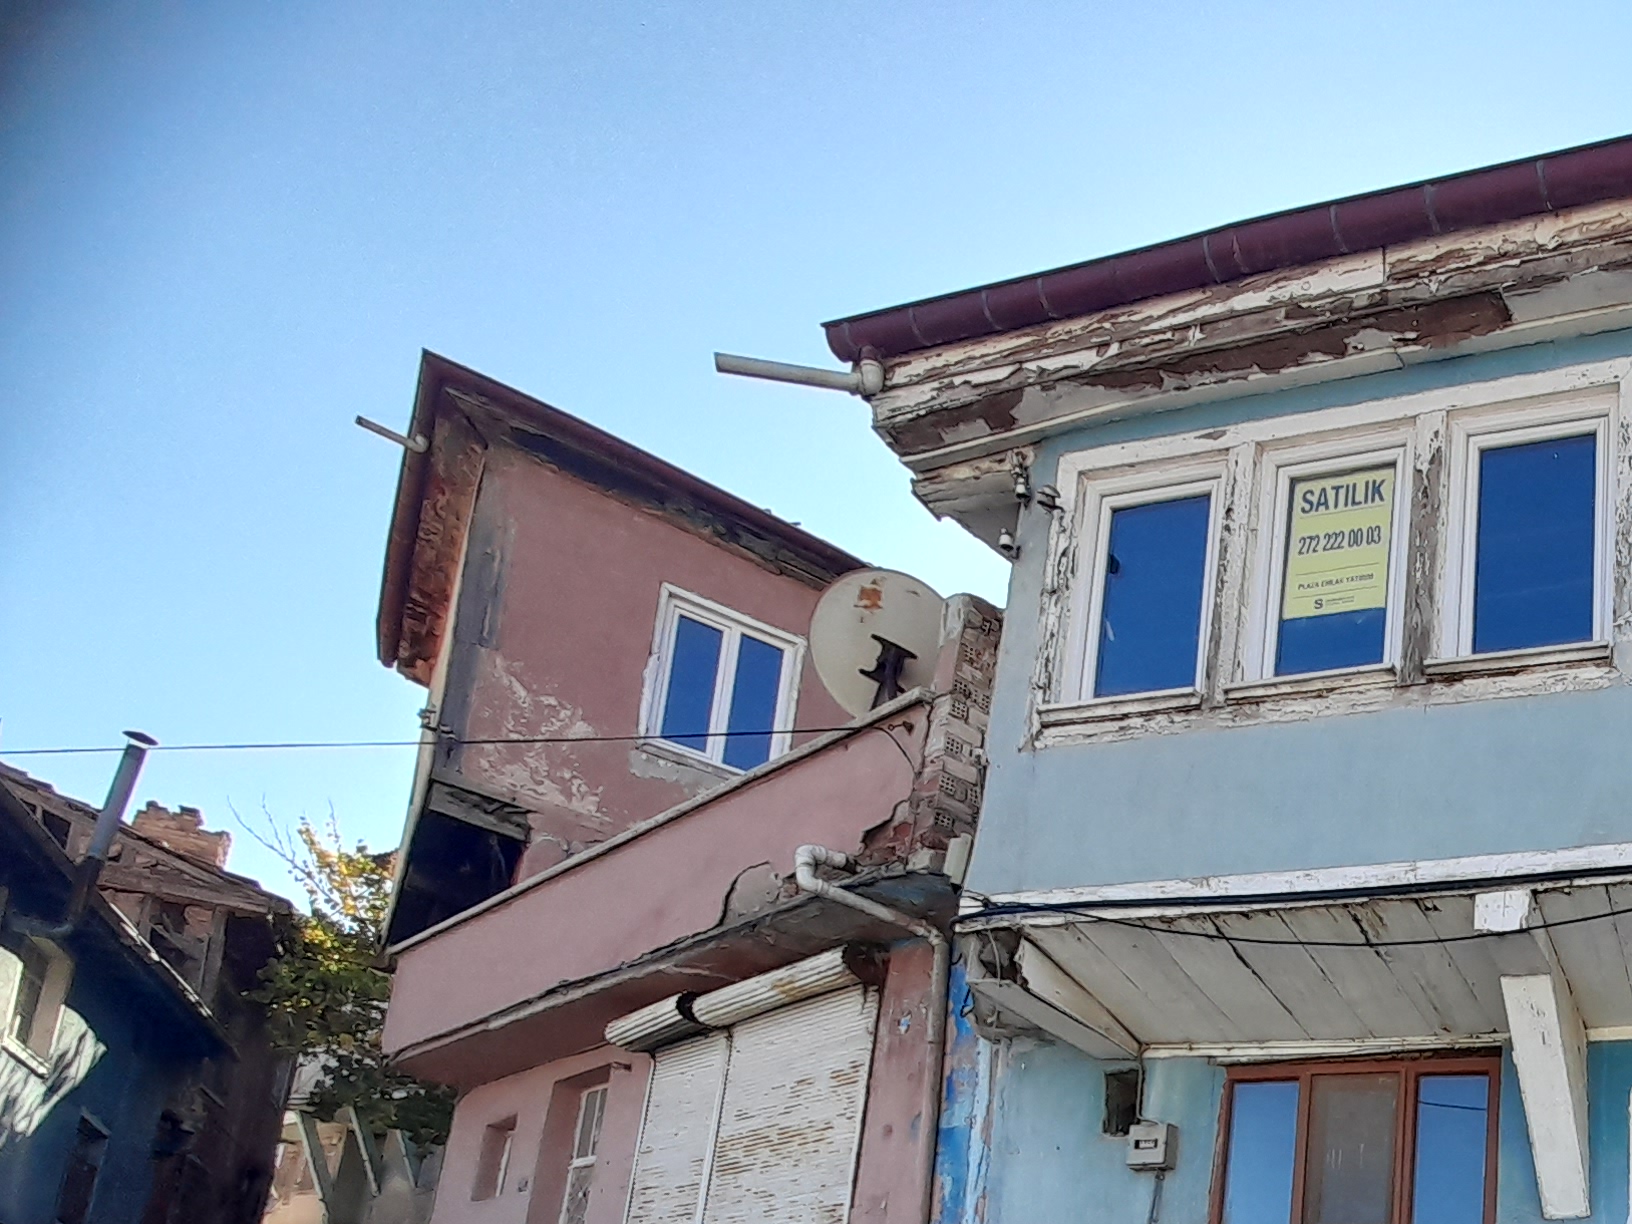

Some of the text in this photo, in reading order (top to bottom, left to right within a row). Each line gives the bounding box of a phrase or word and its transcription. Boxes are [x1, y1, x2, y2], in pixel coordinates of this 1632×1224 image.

[1301, 479, 1386, 514] SATILIK
[1298, 525, 1381, 556] 272 222 00 03
